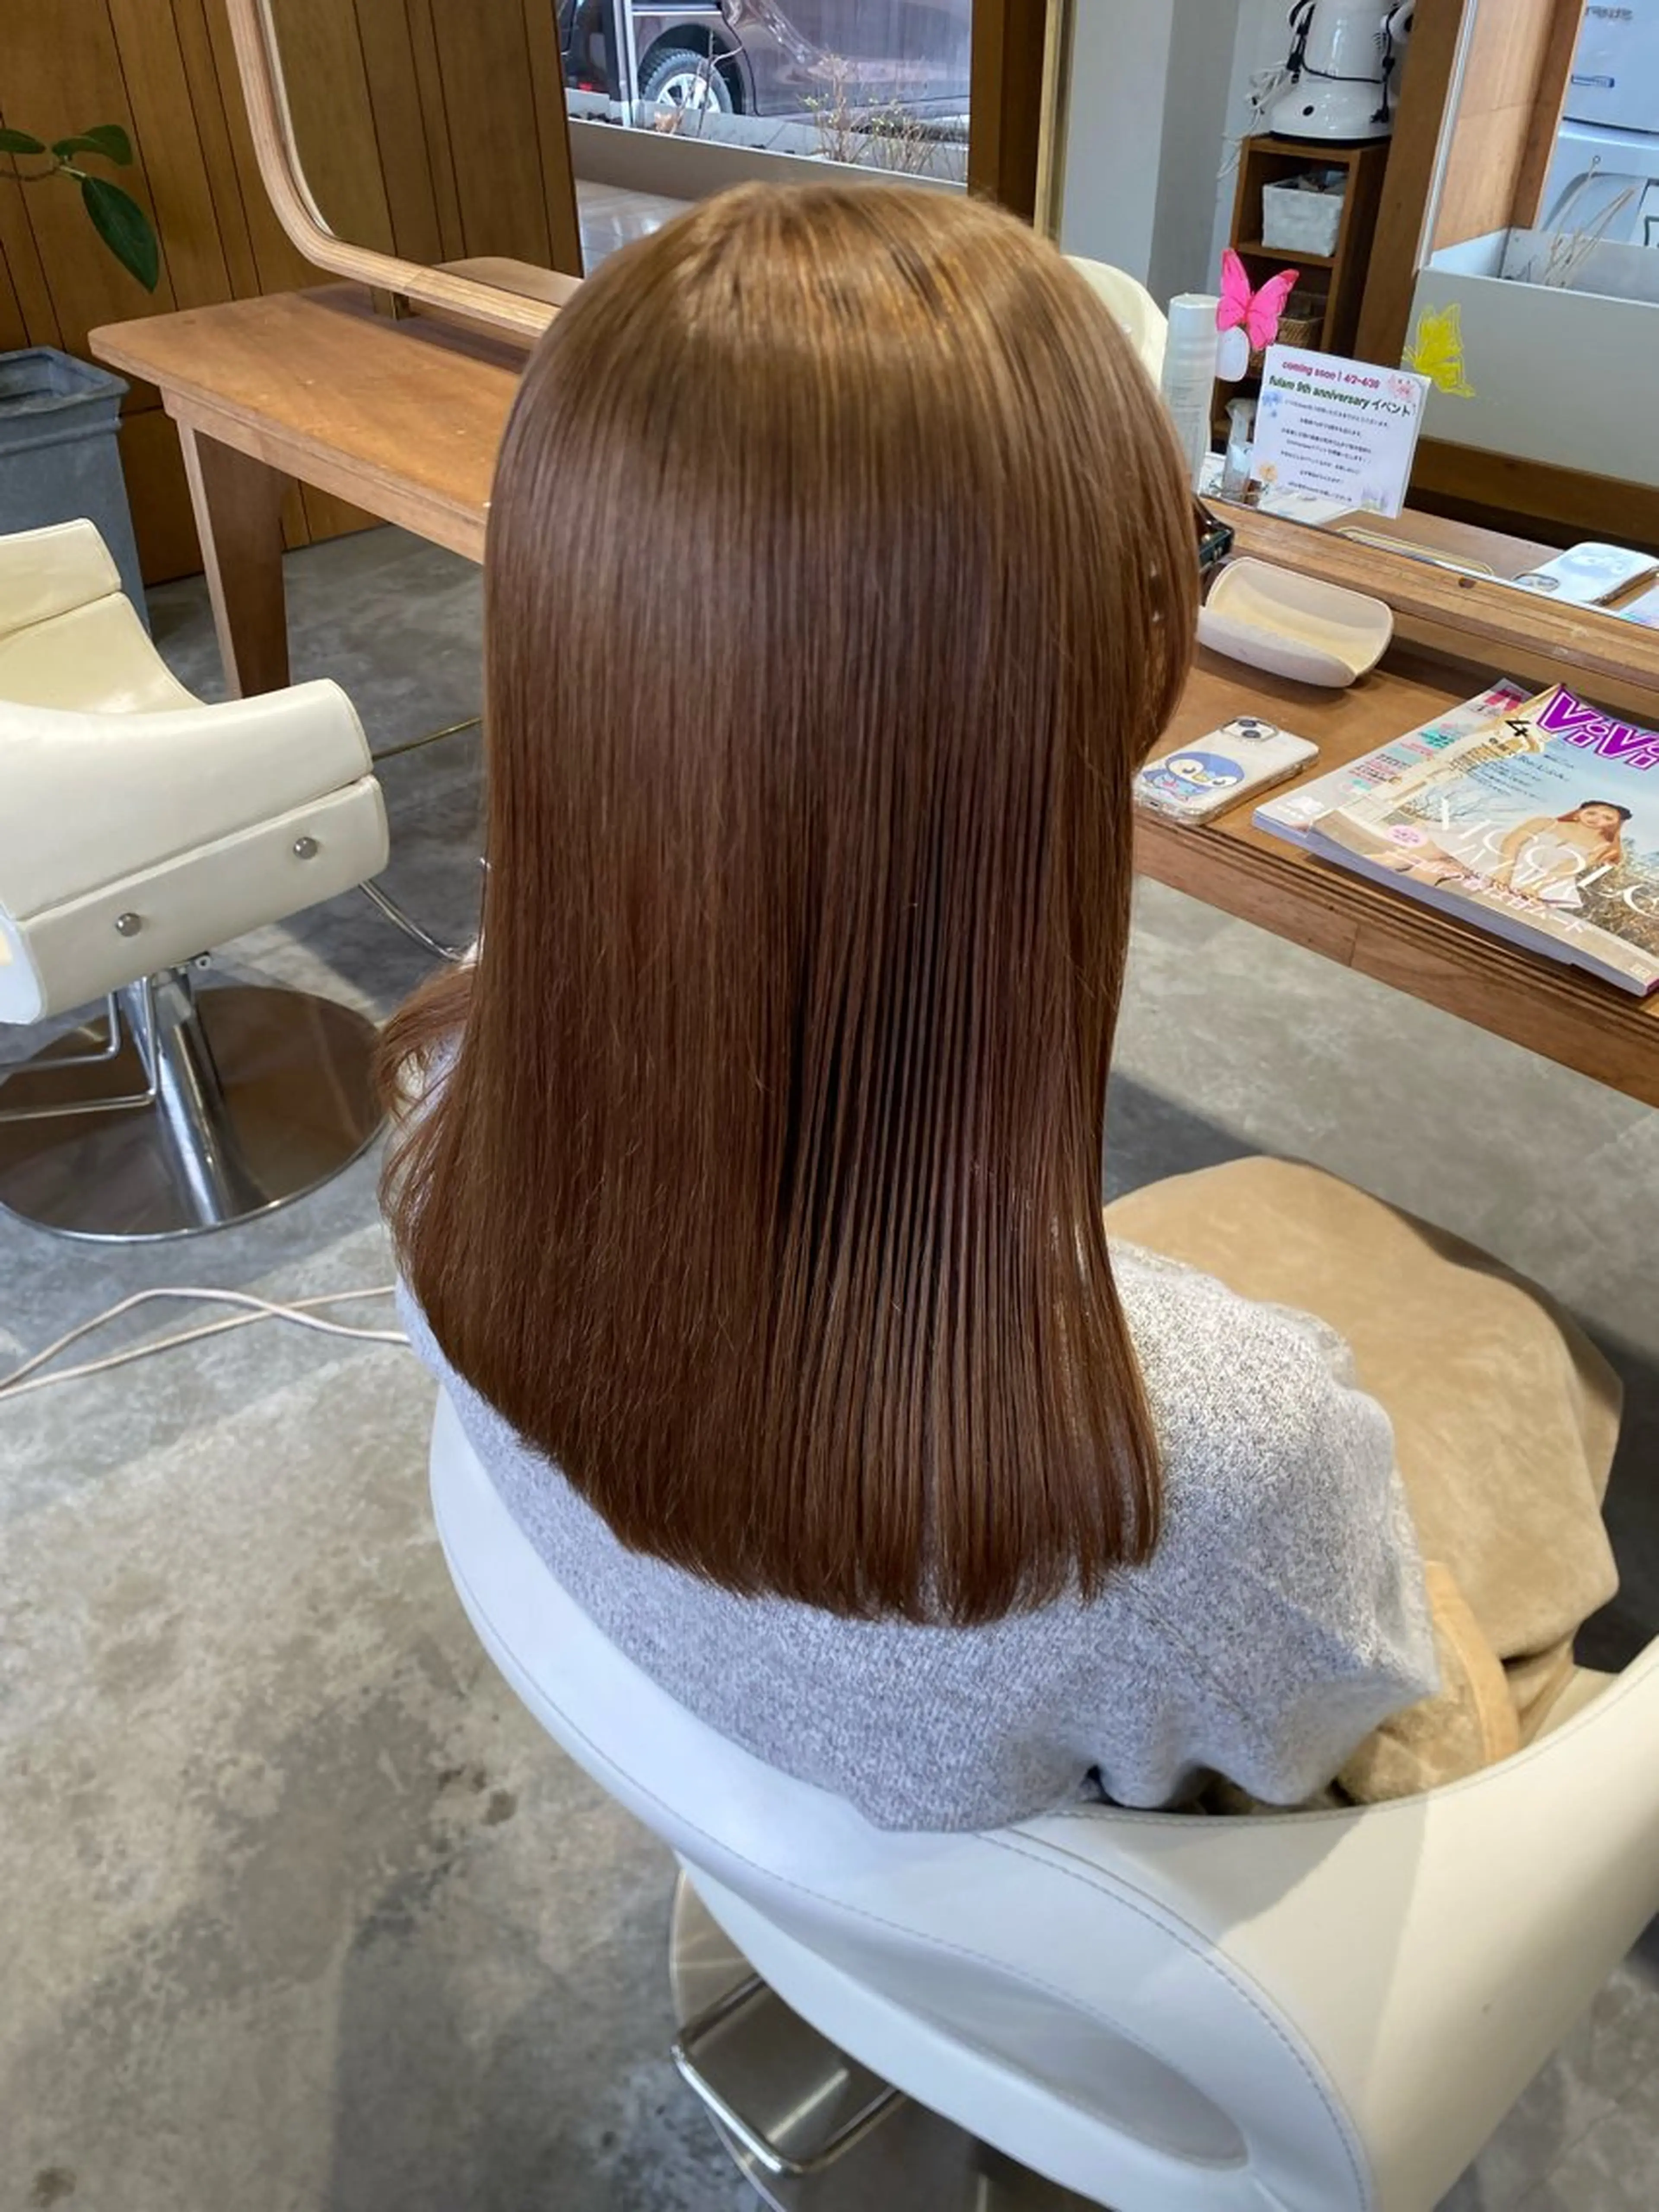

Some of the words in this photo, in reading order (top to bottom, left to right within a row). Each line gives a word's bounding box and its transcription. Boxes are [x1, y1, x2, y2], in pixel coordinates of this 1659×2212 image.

[1282, 361, 1313, 376] coming
[1315, 369, 1336, 380] soon
[1313, 388, 1370, 410] anniversary
[1372, 398, 1411, 417] イベント
